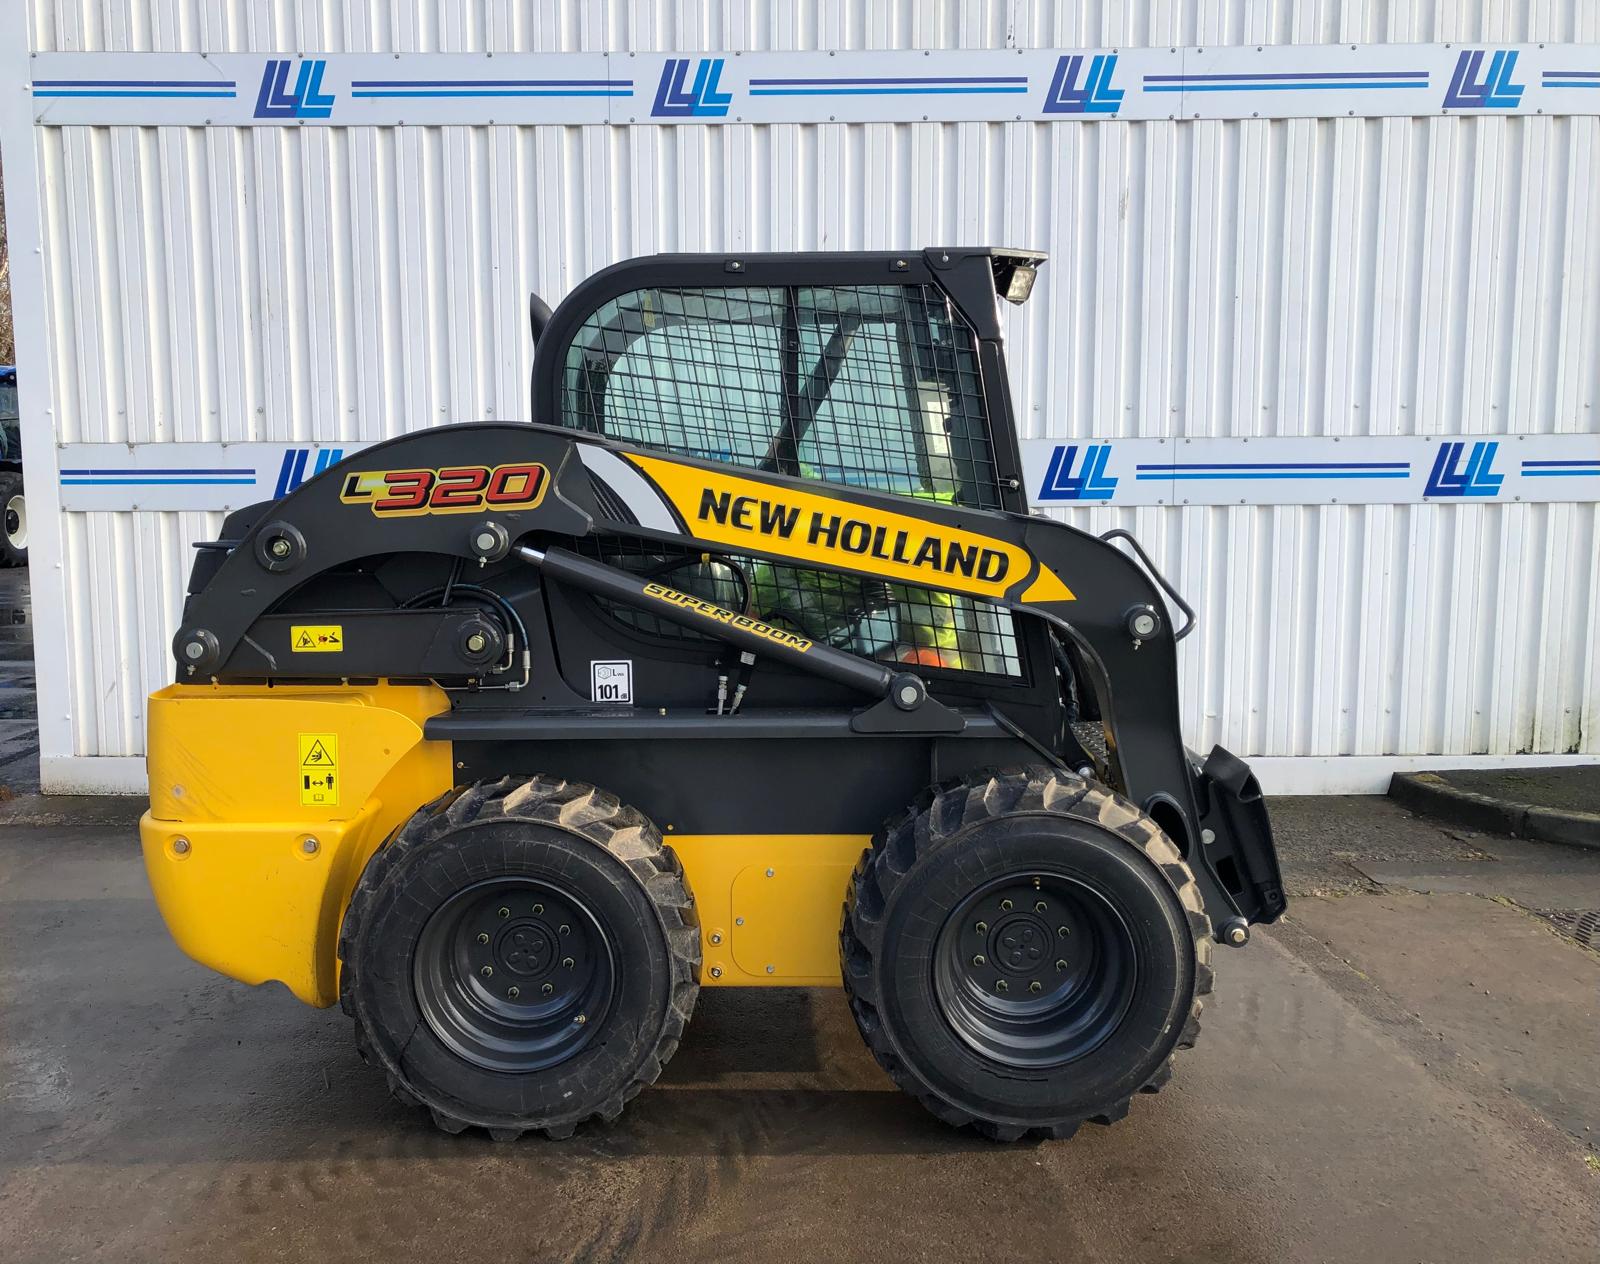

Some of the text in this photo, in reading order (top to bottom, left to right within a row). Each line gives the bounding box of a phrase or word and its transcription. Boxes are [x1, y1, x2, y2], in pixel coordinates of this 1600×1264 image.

[341, 463, 550, 518] L320
[698, 487, 1010, 583] NEW HOLLAND
[643, 583, 813, 652] SUPER BOOM
[597, 684, 619, 700] 101
